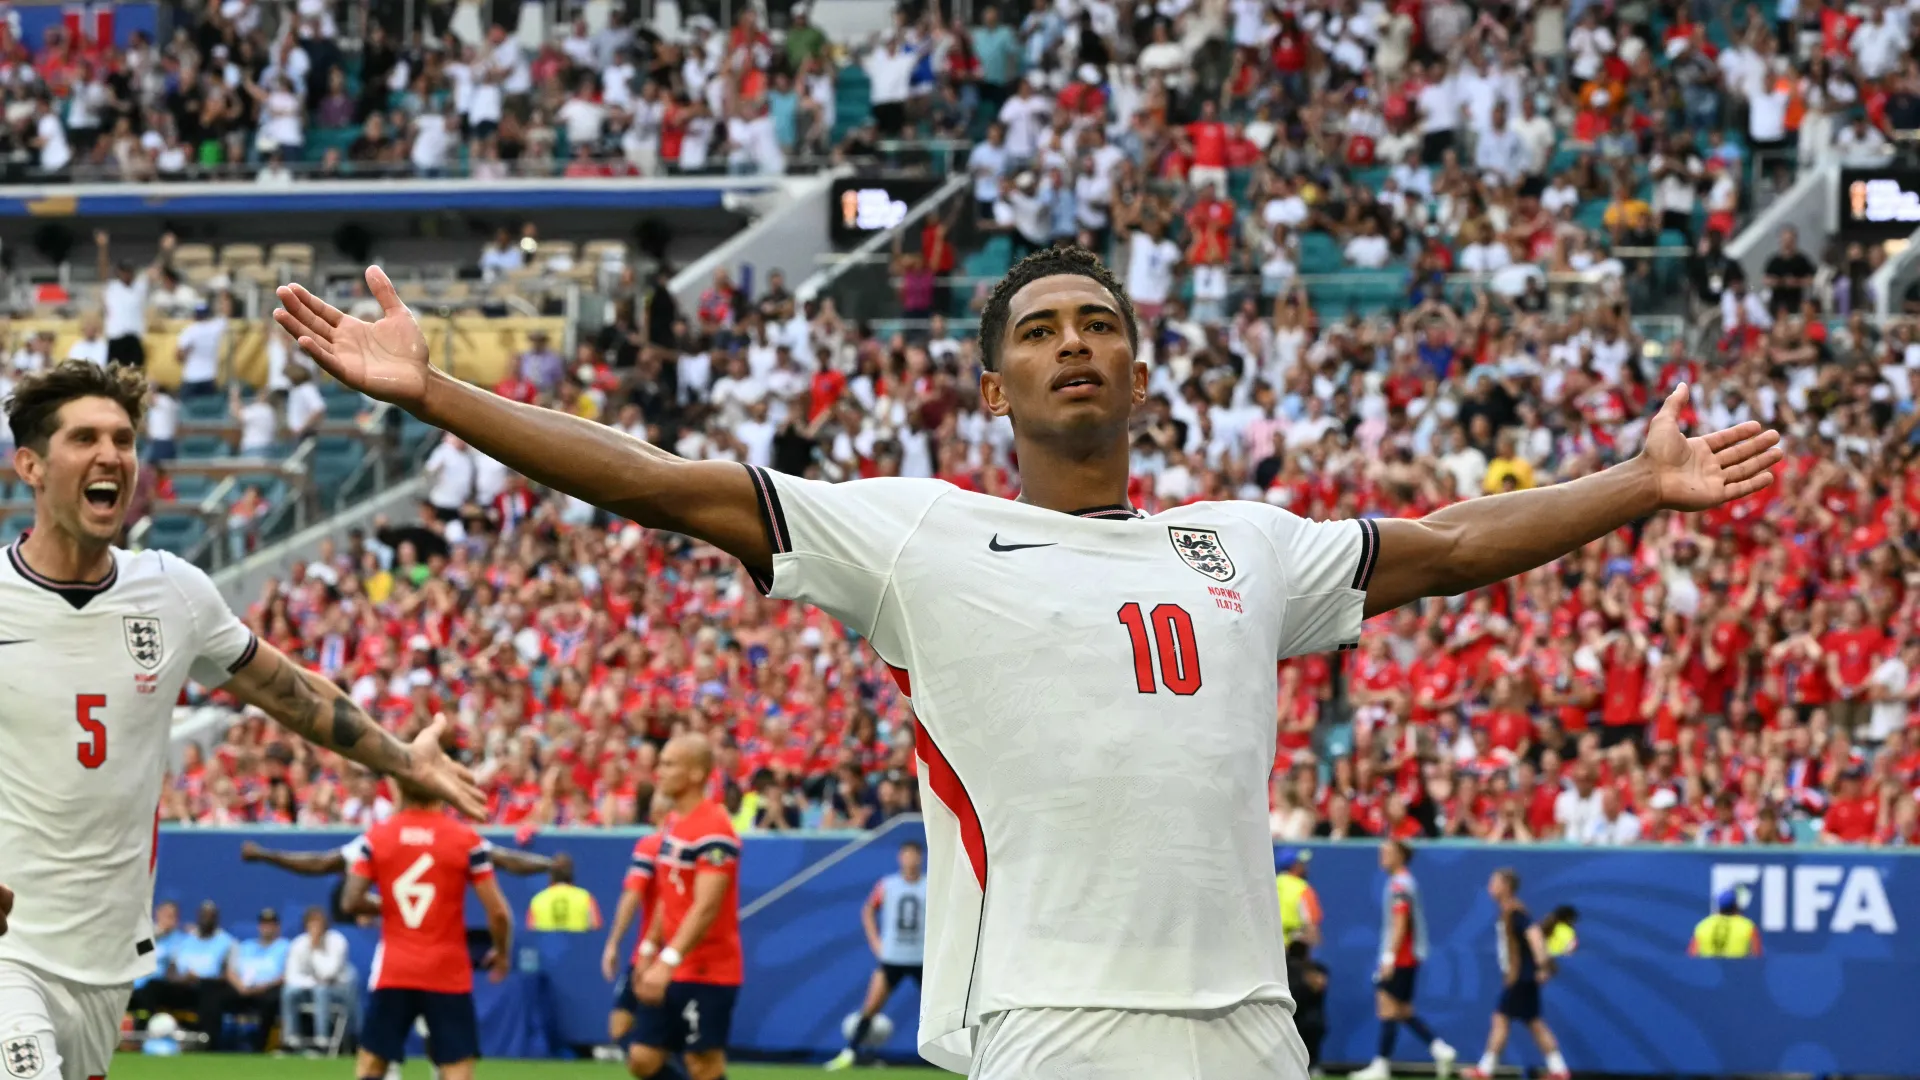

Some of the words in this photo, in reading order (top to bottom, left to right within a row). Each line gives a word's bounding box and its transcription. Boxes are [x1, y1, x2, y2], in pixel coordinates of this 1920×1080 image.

[1207, 585, 1242, 601] NORWAY
[1116, 602, 1202, 696] 10
[76, 693, 107, 769] 5
[392, 852, 436, 928] 6
[1711, 864, 1898, 933] FIFA
